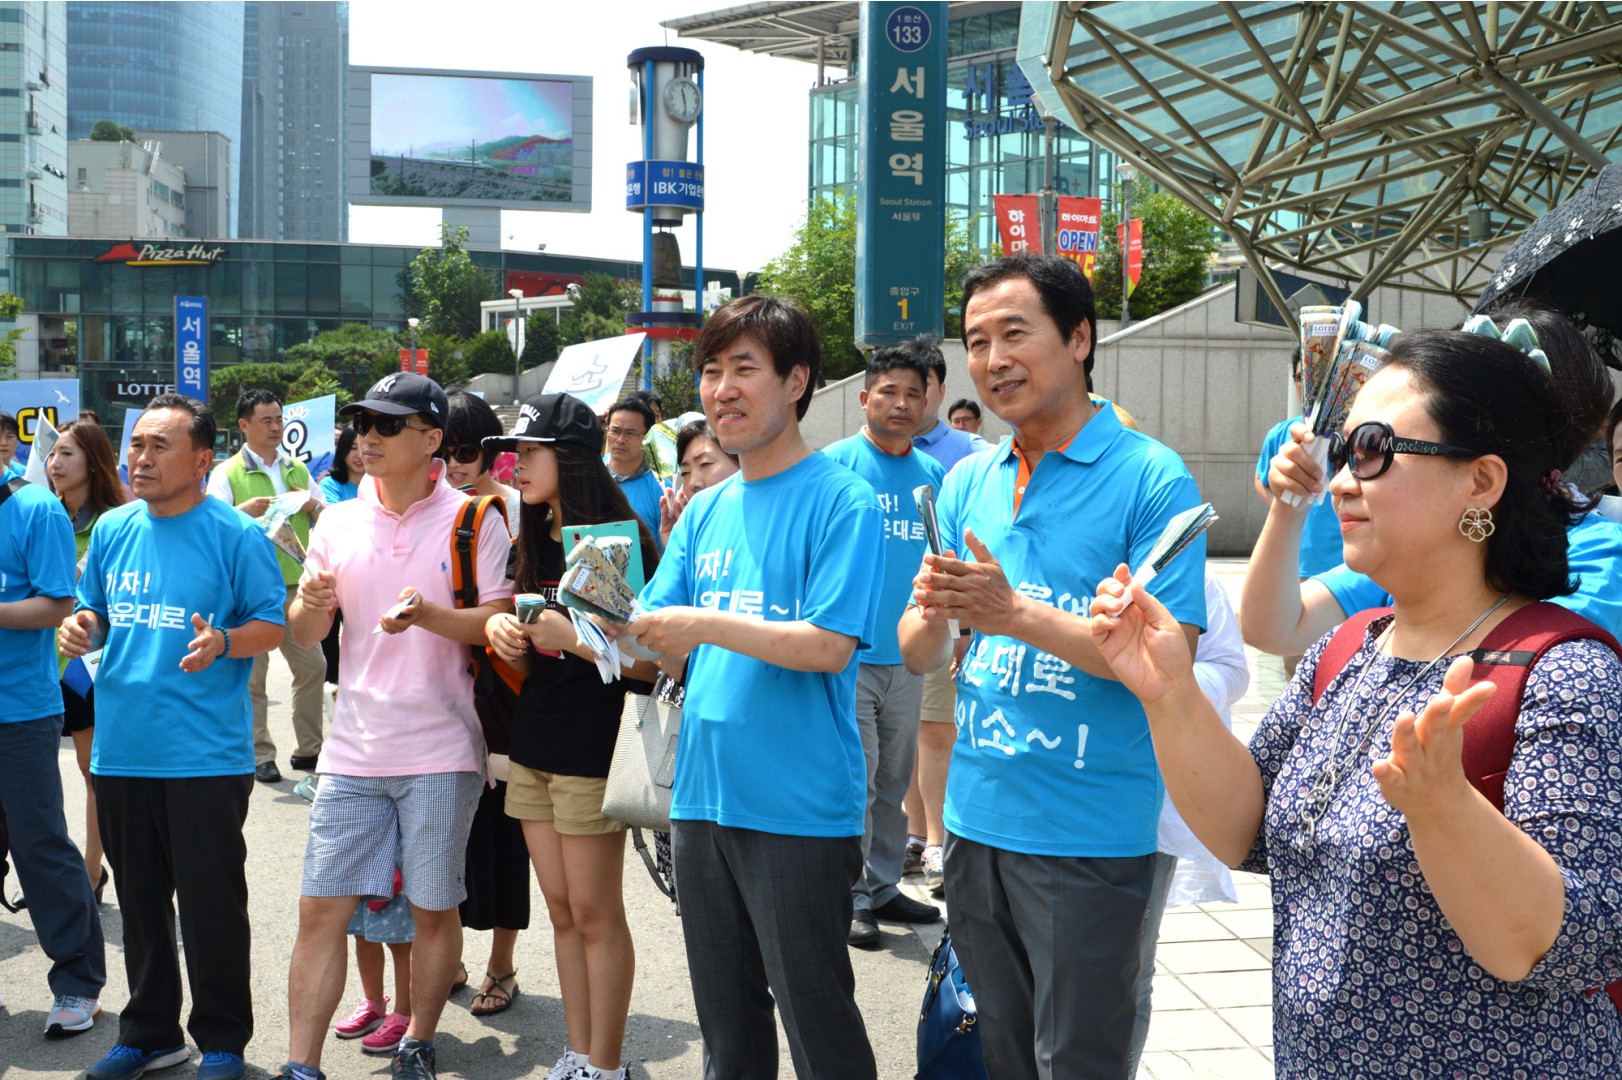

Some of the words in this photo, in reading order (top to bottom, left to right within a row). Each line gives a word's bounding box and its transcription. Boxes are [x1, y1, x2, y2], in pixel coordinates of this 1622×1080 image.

[893, 26, 921, 43] 133
[888, 66, 926, 186] 서울역
[963, 110, 1015, 140] Seoul
[880, 197, 902, 206] Seoul
[904, 198, 932, 207] Station
[1061, 213, 1098, 224] 하이마트
[1058, 229, 1097, 252] OPEN
[138, 244, 184, 261] Pizza
[186, 244, 224, 260] Hut
[897, 298, 908, 320] 1
[893, 322, 914, 331] EXIT
[182, 316, 201, 390] 서울역
[961, 637, 1077, 701] 운대로
